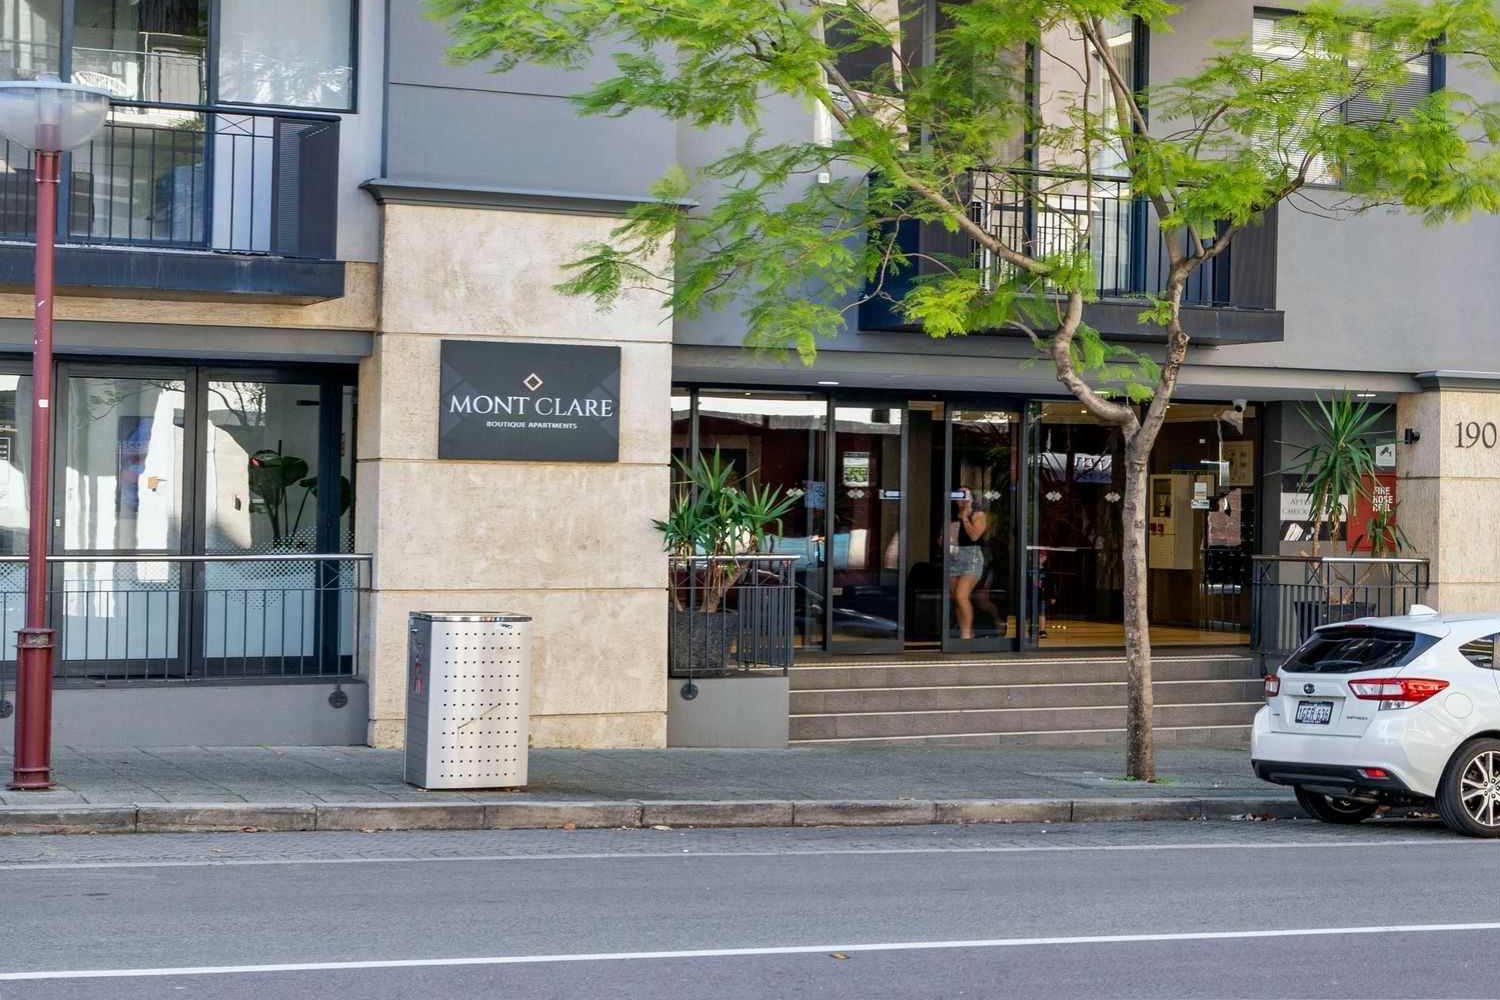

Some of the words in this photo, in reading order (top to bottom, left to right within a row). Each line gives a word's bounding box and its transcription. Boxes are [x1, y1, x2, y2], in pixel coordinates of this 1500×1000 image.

[449, 394, 530, 415] MONT
[535, 397, 613, 417] CLARE
[1455, 421, 1497, 449] 190
[1372, 503, 1392, 512] REL
